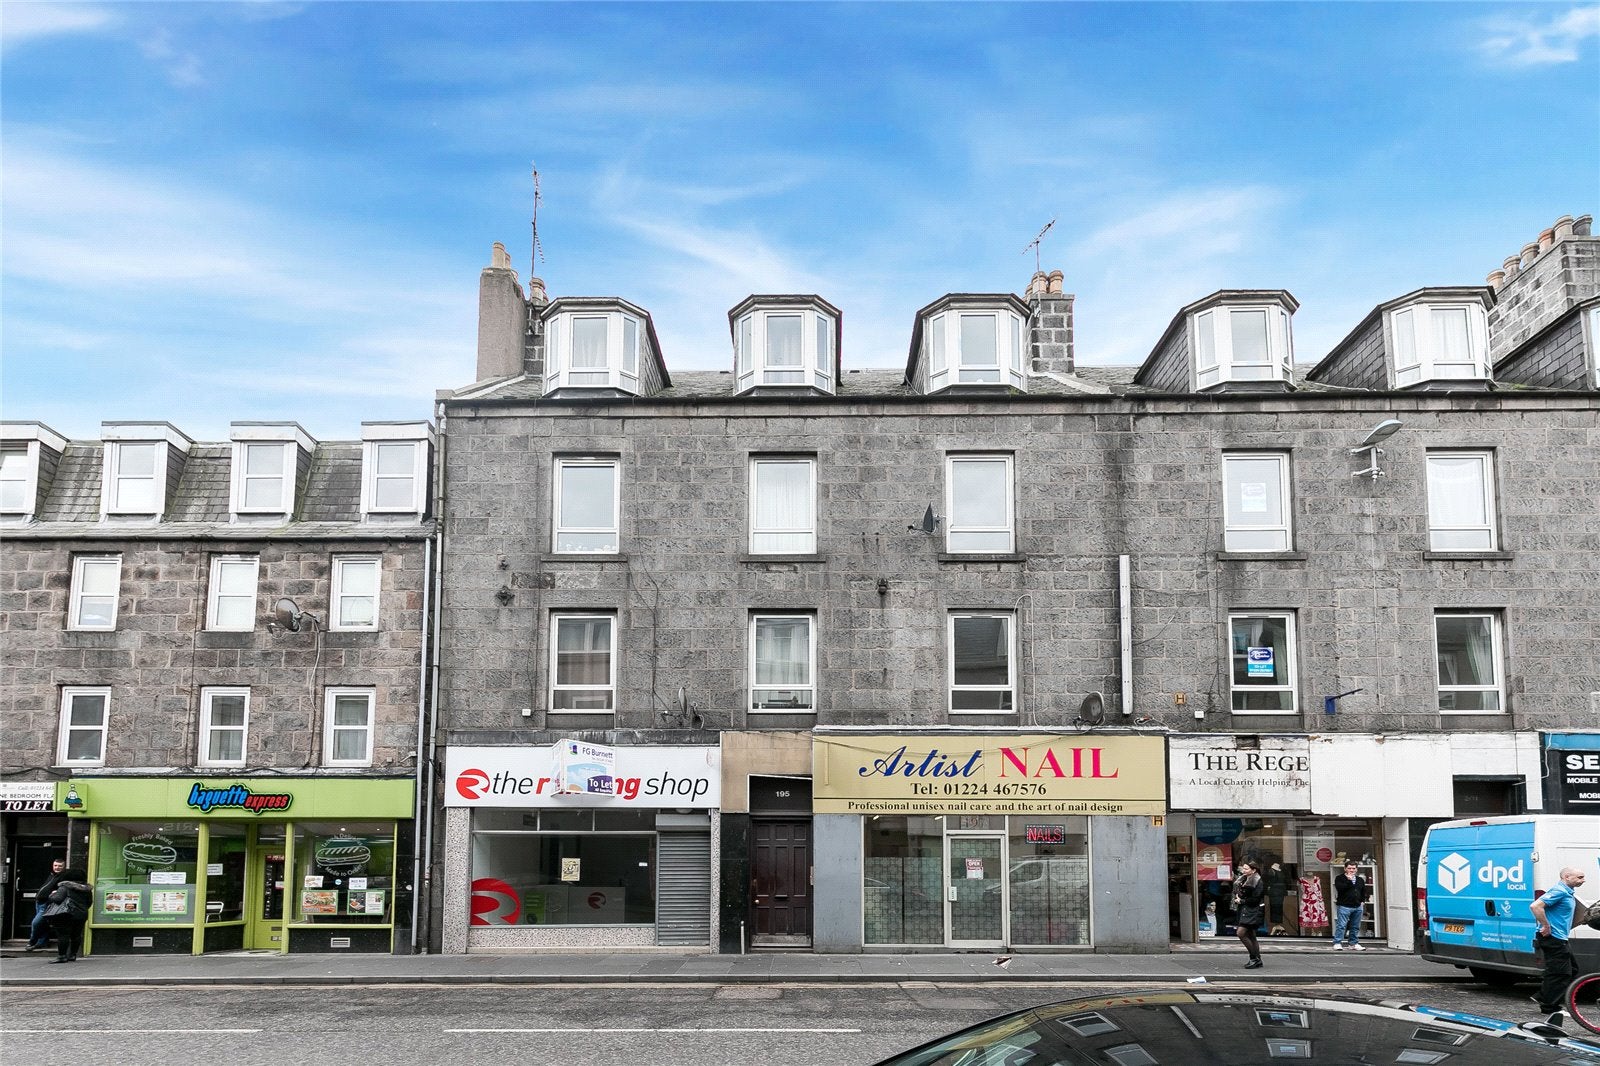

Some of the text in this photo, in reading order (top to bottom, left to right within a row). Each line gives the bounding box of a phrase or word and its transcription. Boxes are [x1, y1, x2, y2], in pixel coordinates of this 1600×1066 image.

[582, 747, 614, 759] FG Burnett
[858, 745, 1120, 779] Artist NAIL
[1187, 752, 1309, 772] THE REGE
[1566, 754, 1600, 770] SE
[492, 770, 533, 795] the
[644, 771, 709, 802] shop
[589, 778, 599, 788] To
[600, 780, 613, 789] Let
[910, 782, 1047, 796] Tel: 01224 467576
[1199, 778, 1221, 786] Local
[1223, 778, 1255, 788] Charity
[1257, 778, 1291, 788] Helping
[188, 783, 290, 812] baguette express
[775, 790, 790, 798] 195
[5, 801, 51, 811] TO LET
[848, 801, 1123, 813] Professional unisex nail care and the art of nail design
[131, 832, 173, 845] Freshly Baked
[1028, 827, 1063, 842] NAILS
[324, 866, 340, 877] Made
[1478, 859, 1523, 888] dpd
[1507, 882, 1526, 890] local
